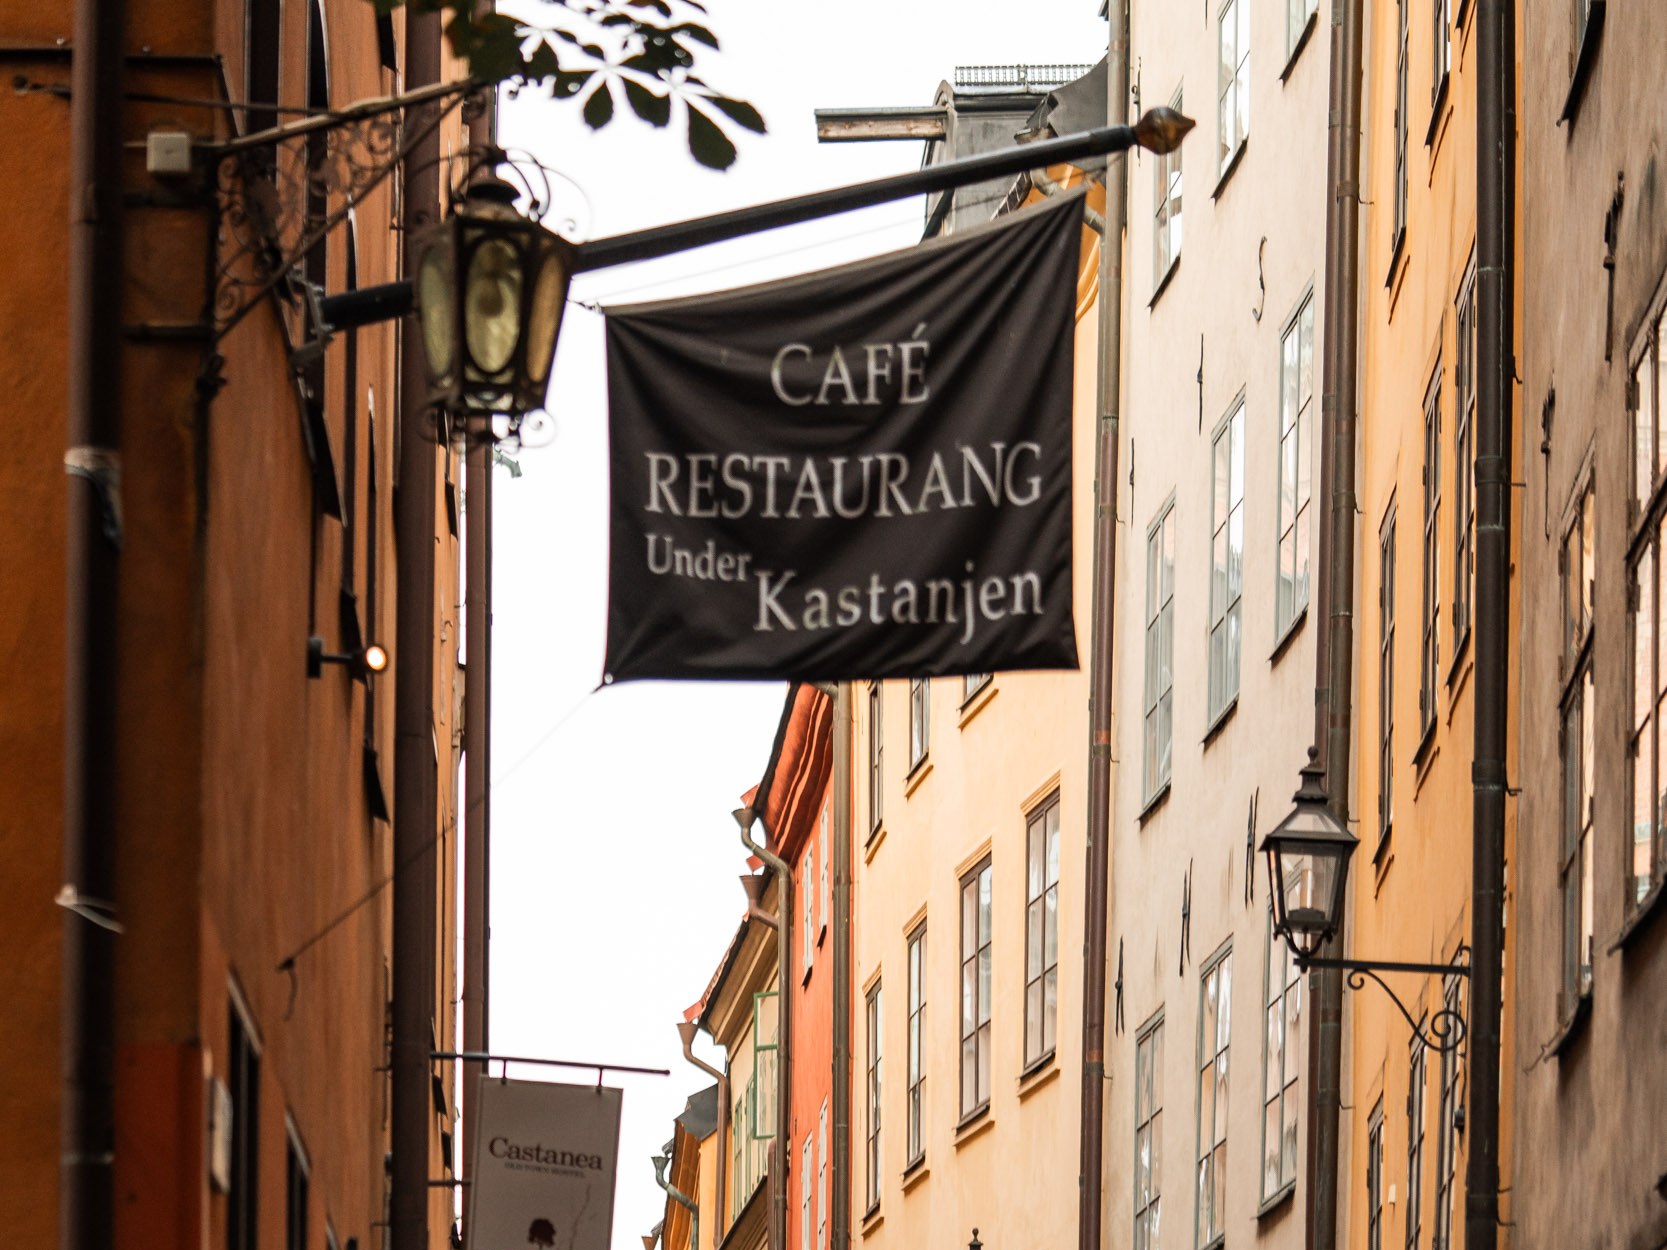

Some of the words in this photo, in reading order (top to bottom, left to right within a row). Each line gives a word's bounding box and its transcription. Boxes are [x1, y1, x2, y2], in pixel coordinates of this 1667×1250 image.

[770, 322, 930, 406] CAFÉ
[644, 441, 1042, 518] RESTAURANG
[645, 533, 751, 582] Under
[753, 560, 1044, 645] Kastanjen
[489, 1136, 602, 1171] Castanea
